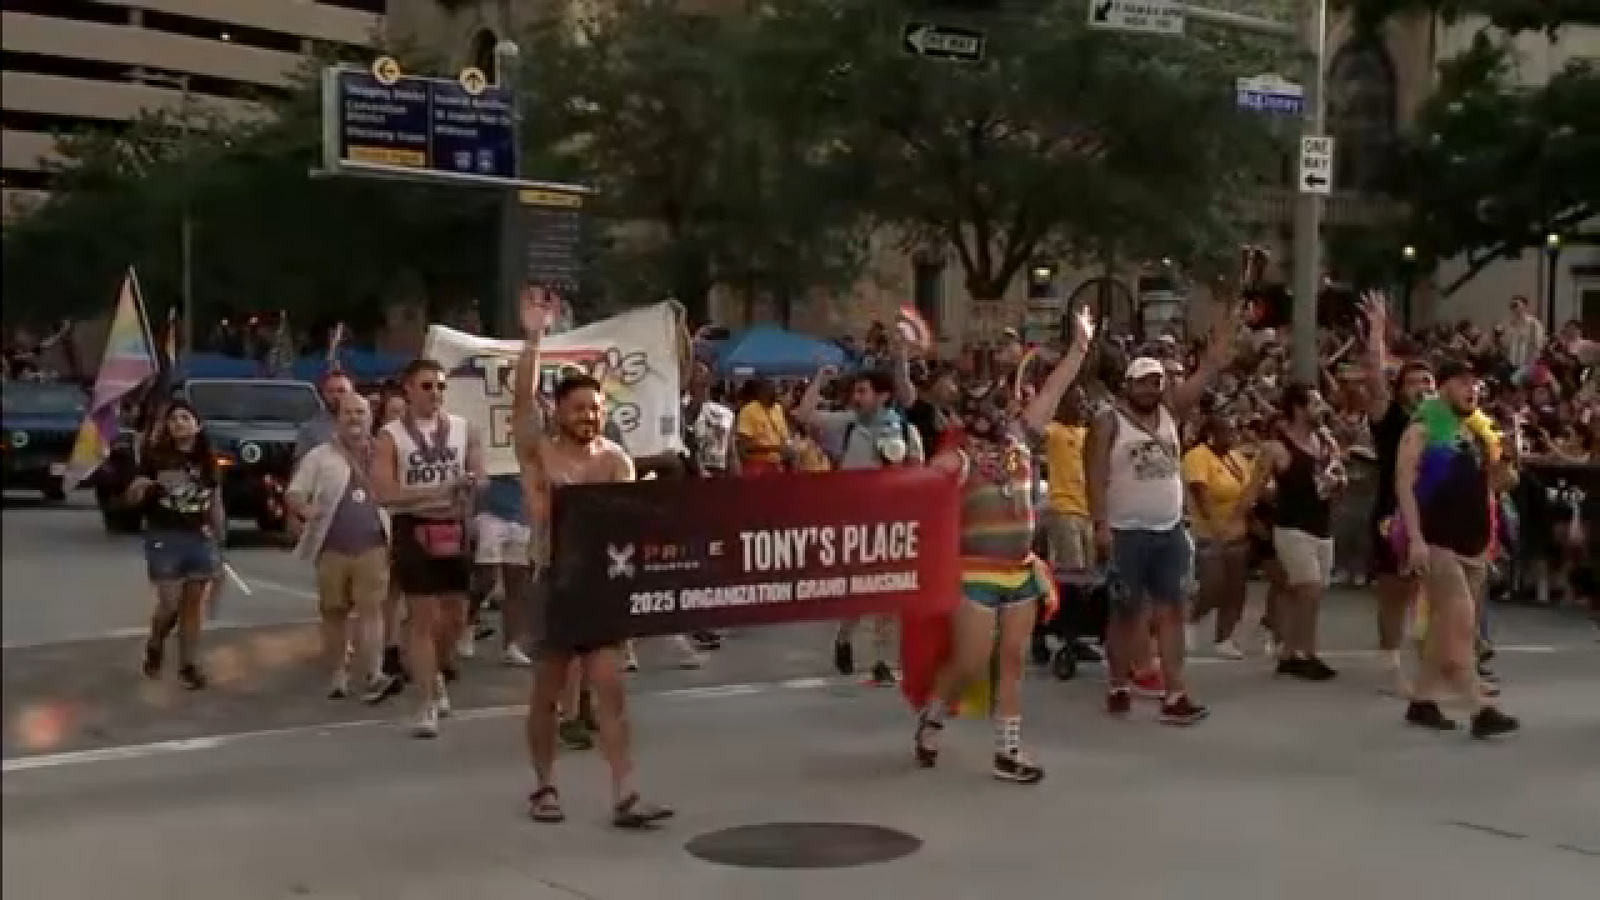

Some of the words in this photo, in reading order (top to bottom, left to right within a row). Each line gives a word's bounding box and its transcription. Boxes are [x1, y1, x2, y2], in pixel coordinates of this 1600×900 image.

[1304, 139, 1329, 154] ONE
[740, 526, 836, 573] TONY'S
[842, 520, 921, 565] PLACE
[629, 589, 676, 616] 2025
[679, 581, 793, 611] ORGANIZATION
[795, 576, 848, 601] GRAND
[849, 570, 921, 595] MARSHAL
